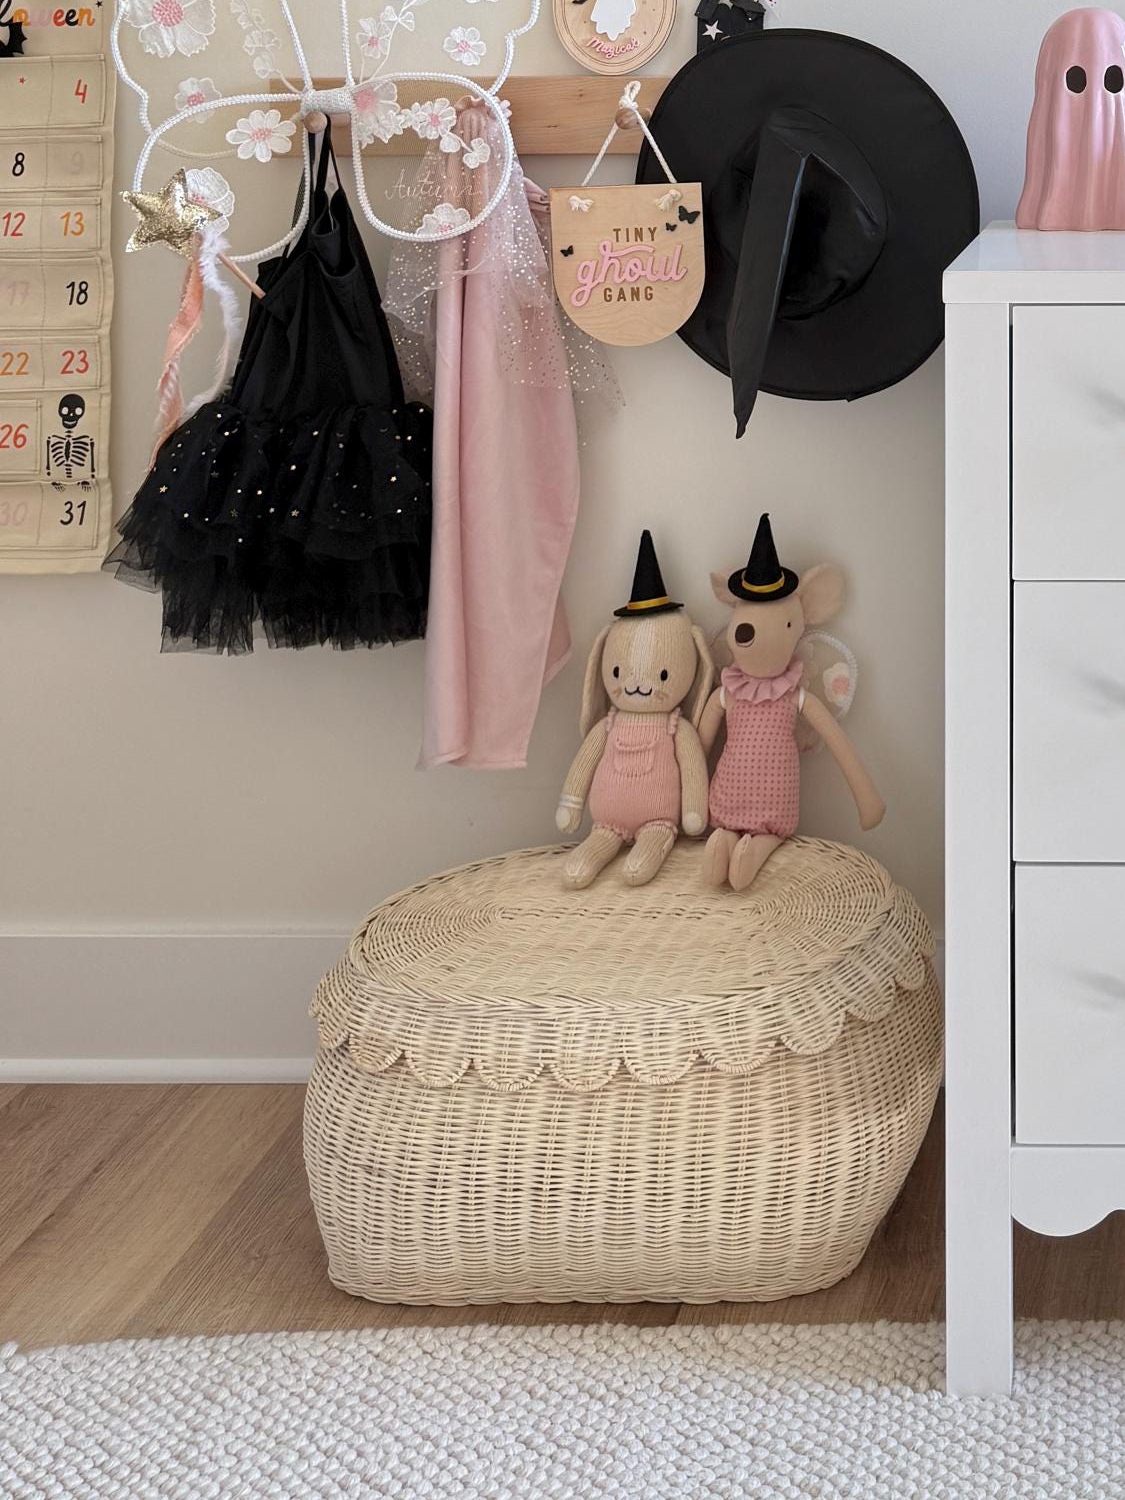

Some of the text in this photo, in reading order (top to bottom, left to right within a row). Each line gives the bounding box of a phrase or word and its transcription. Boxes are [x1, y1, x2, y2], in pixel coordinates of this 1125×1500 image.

[584, 36, 641, 59] Magical
[74, 79, 88, 104] 4
[12, 152, 25, 177] 8
[2, 211, 85, 236] 12 13
[612, 226, 658, 243] TINY
[570, 240, 688, 308] ghoul
[8, 280, 89, 306] 17 18
[603, 285, 654, 303] GANG
[0, 349, 90, 376] 22 23
[0, 423, 29, 449] 26
[60, 500, 87, 526] 31
